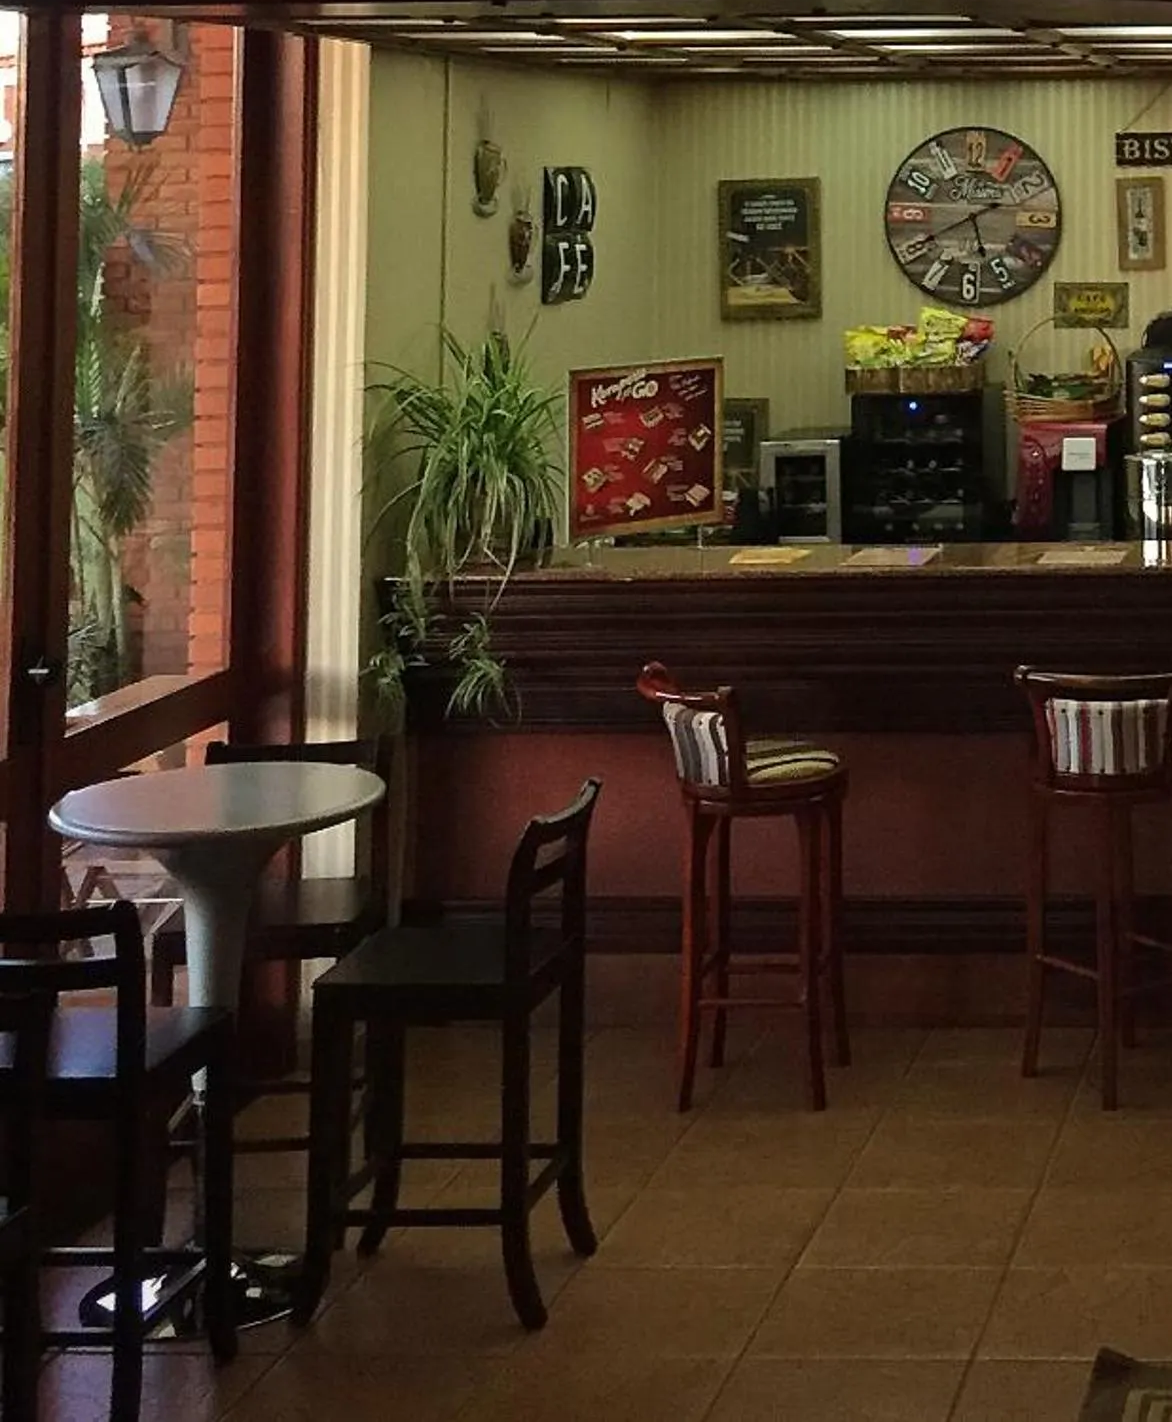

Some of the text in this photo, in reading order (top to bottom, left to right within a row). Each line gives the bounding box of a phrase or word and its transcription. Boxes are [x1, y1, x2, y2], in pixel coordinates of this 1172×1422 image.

[907, 170, 931, 194] 10
[1028, 213, 1051, 225] 3
[990, 259, 1009, 282] 5
[962, 273, 976, 300] 6
